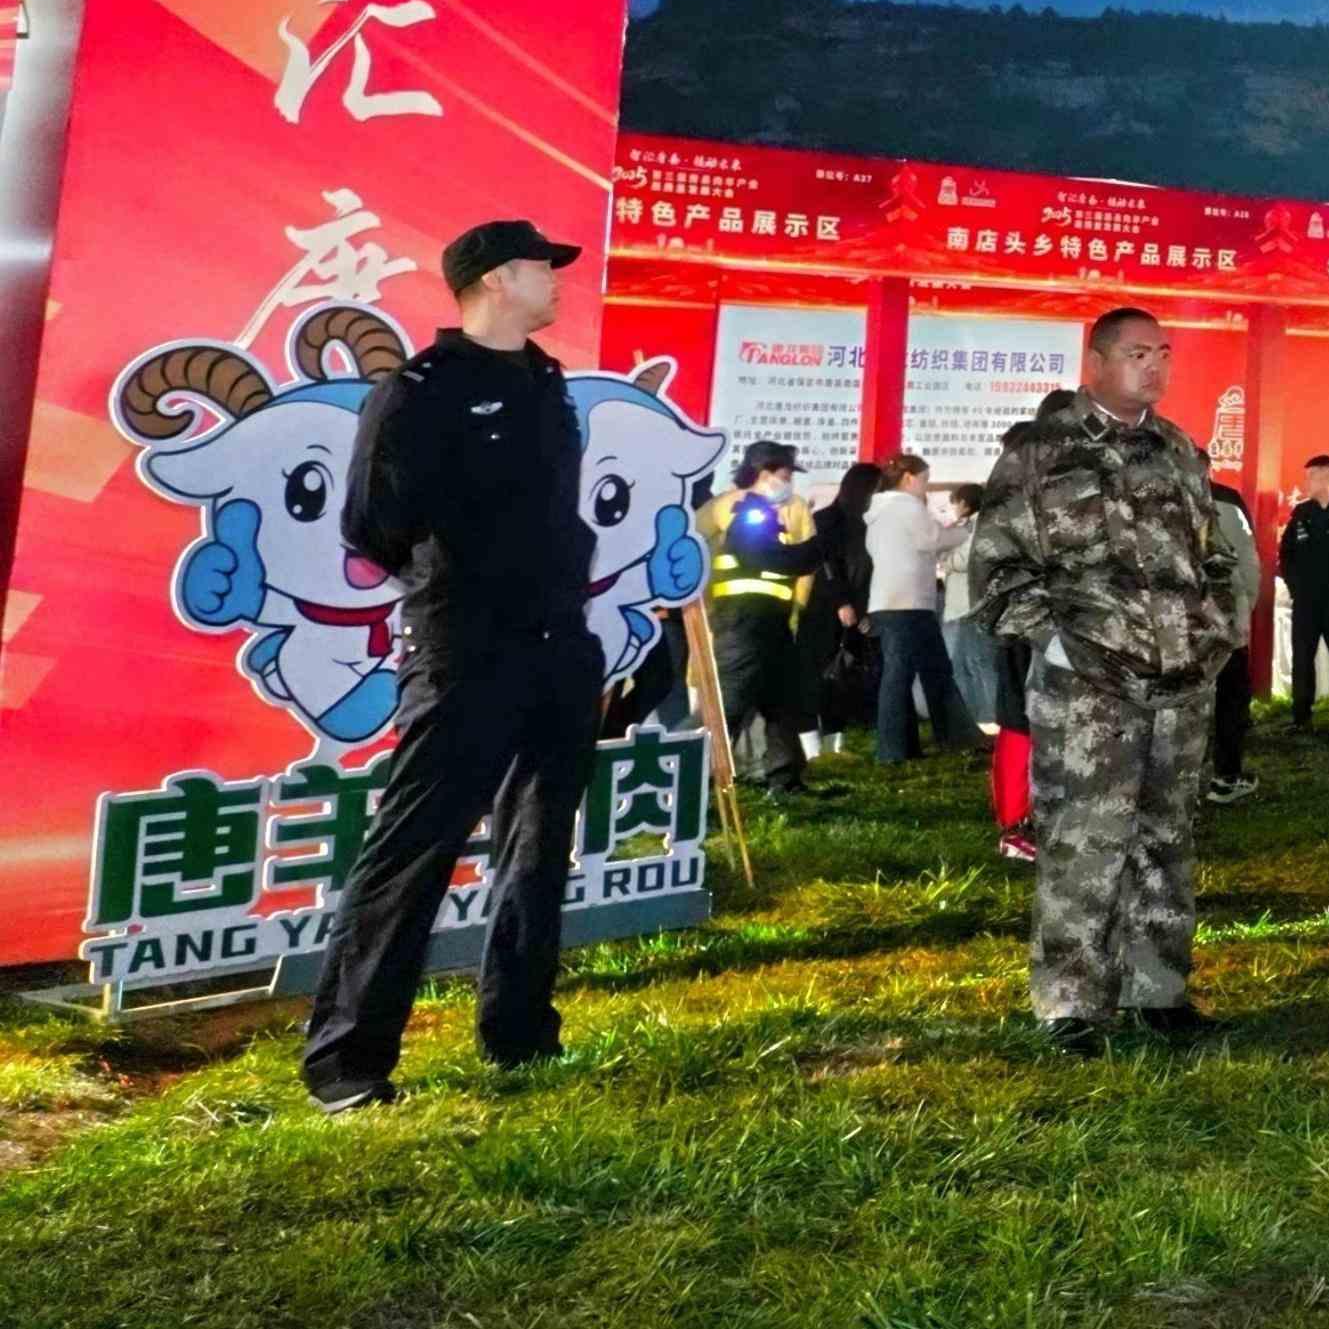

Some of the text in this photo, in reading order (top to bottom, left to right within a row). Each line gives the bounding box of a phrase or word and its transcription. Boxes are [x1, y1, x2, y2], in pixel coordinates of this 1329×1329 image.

[616, 196, 841, 241] 特色产品展示区
[946, 226, 1238, 272] 南店头乡特色产品展示区
[905, 349, 1065, 374] 纺织集团有限公司
[90, 921, 258, 976] TANG
[601, 856, 700, 897] ROU
